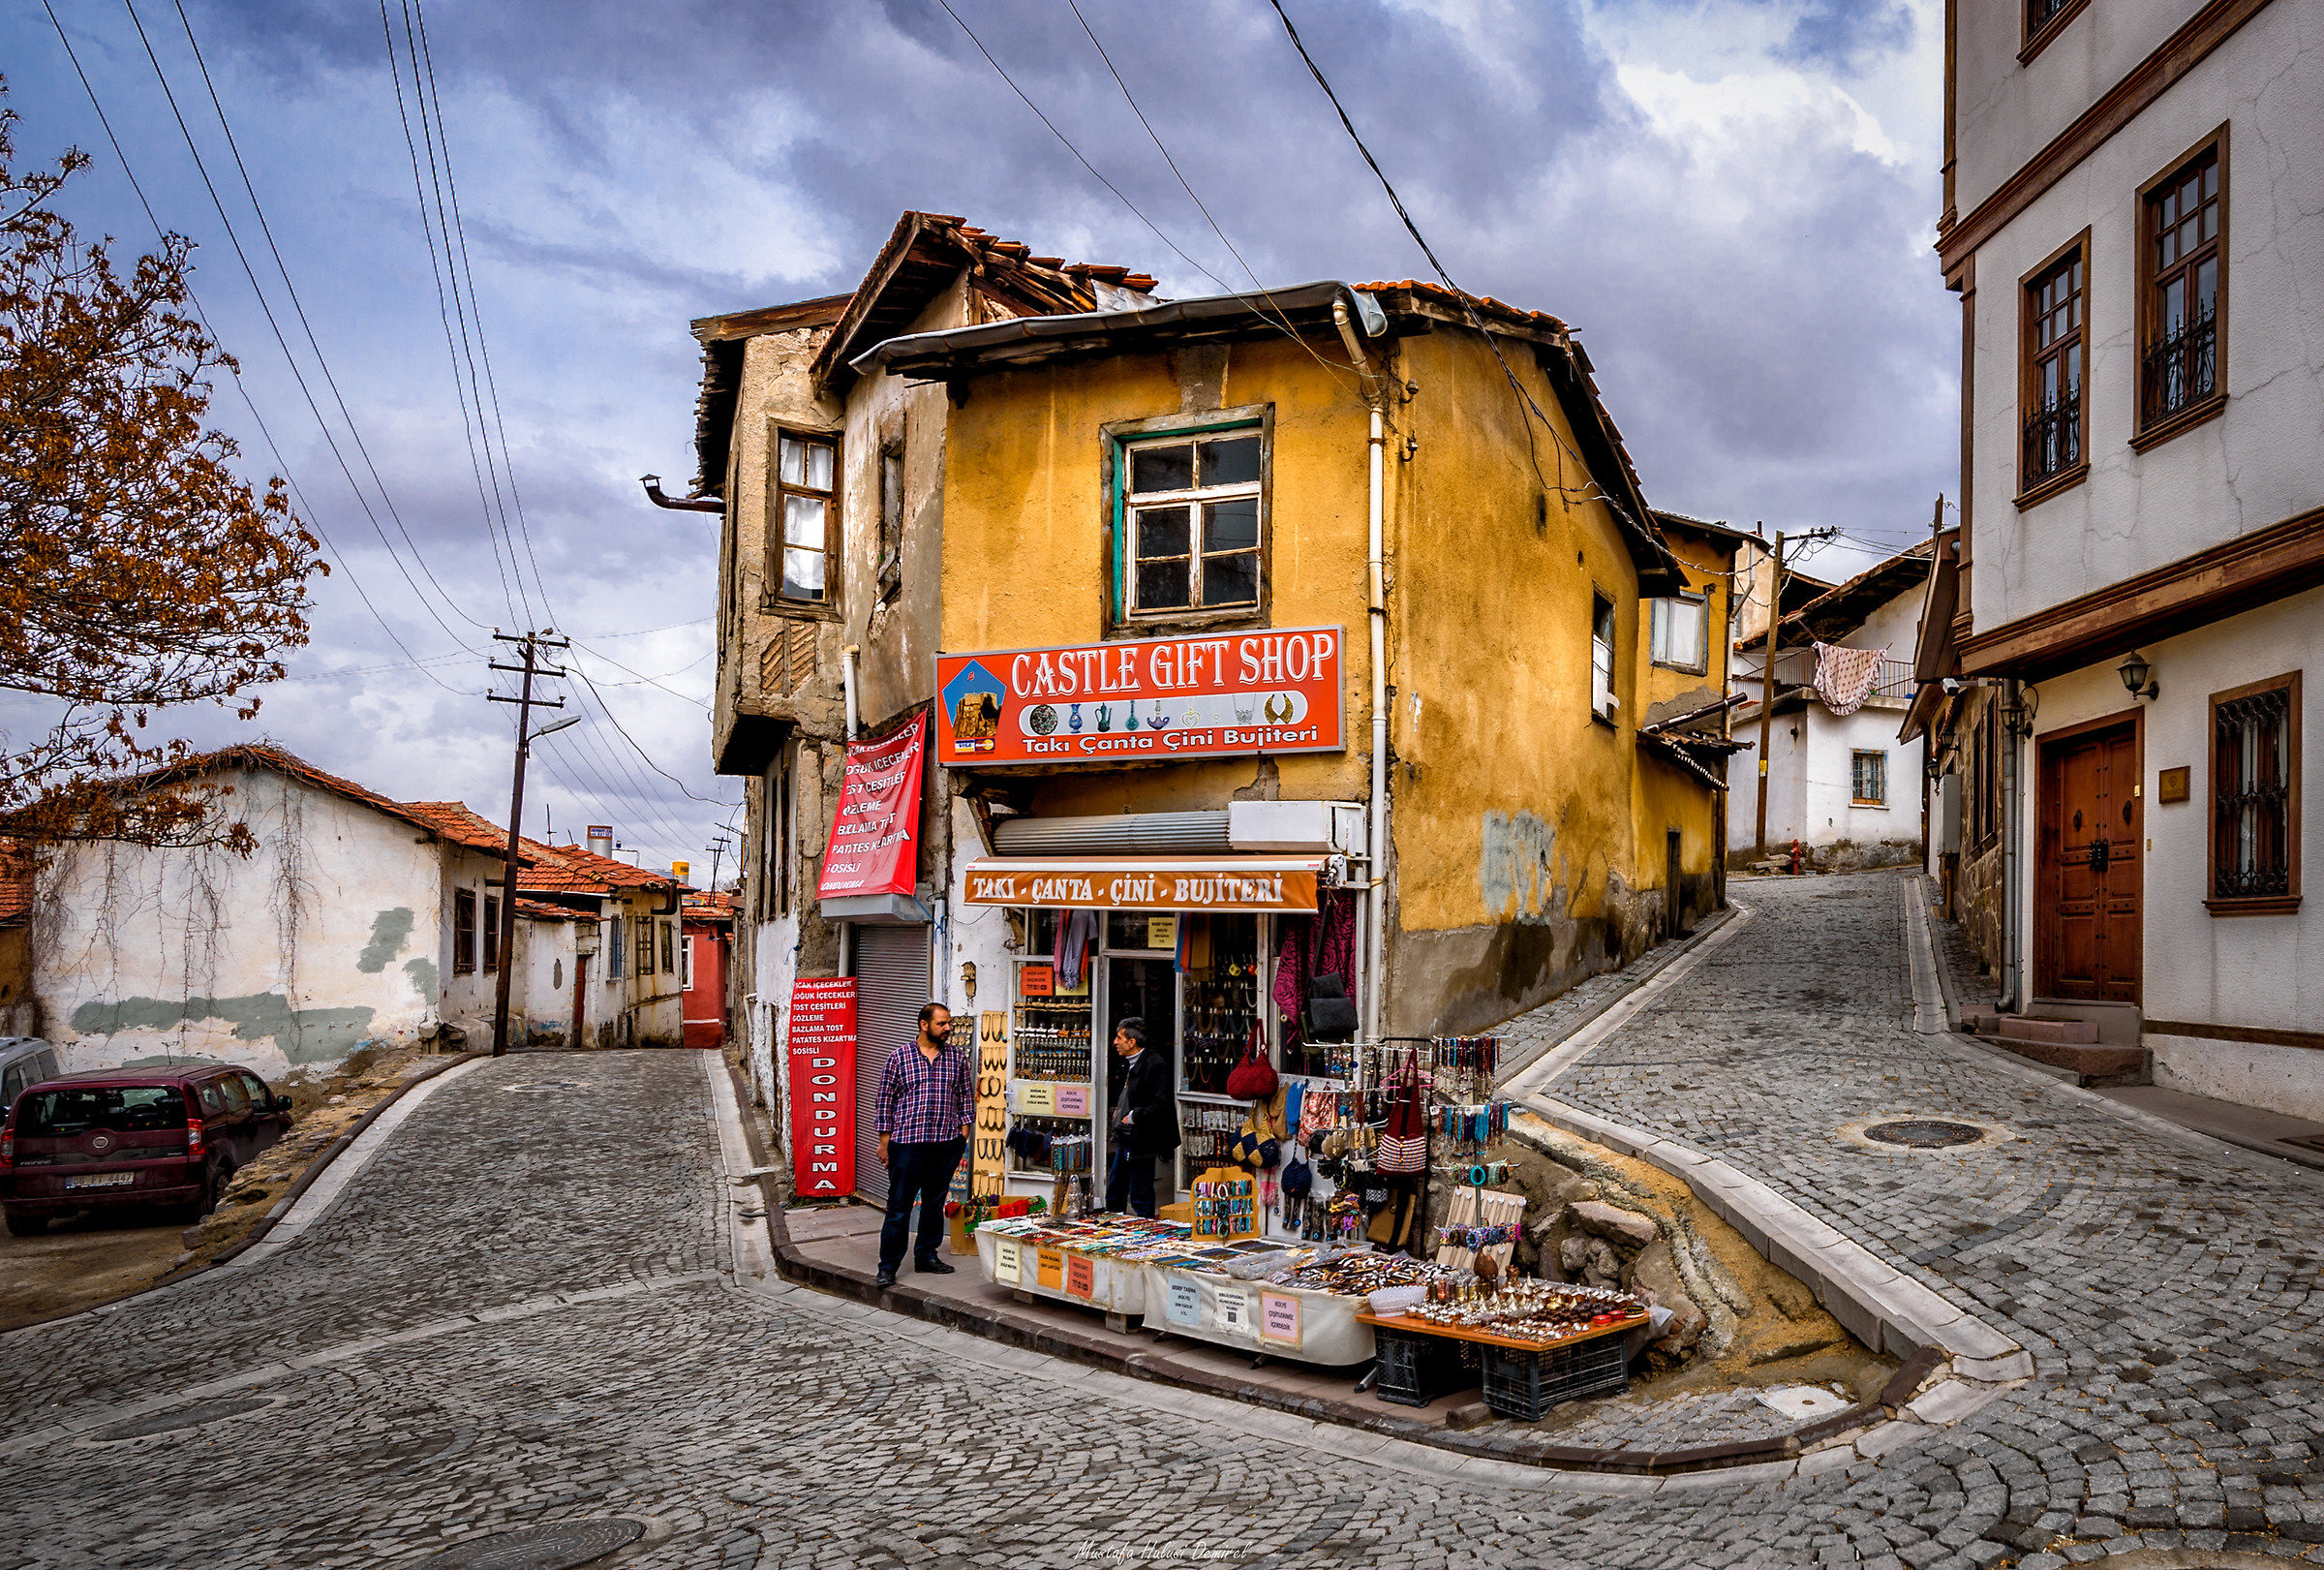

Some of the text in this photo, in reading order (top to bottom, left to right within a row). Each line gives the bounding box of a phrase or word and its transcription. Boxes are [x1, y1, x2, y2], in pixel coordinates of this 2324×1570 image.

[1011, 632, 1335, 698] CASTLE GIFT SHOP
[1022, 724, 1318, 755] Takı Çanta Çini Bujiteri
[973, 877, 1015, 900] TAKI
[1031, 877, 1093, 904] ÇANTA
[1110, 873, 1155, 906] ÇİNİ
[1174, 873, 1283, 905] BUJİTERİ
[791, 1013, 824, 1023] GÖZLEME
[791, 1025, 825, 1033] BAZLAMA
[791, 1035, 822, 1044] PATATES
[791, 1045, 820, 1056] SOSİSLİ
[810, 1057, 838, 1190] DONDURMA
